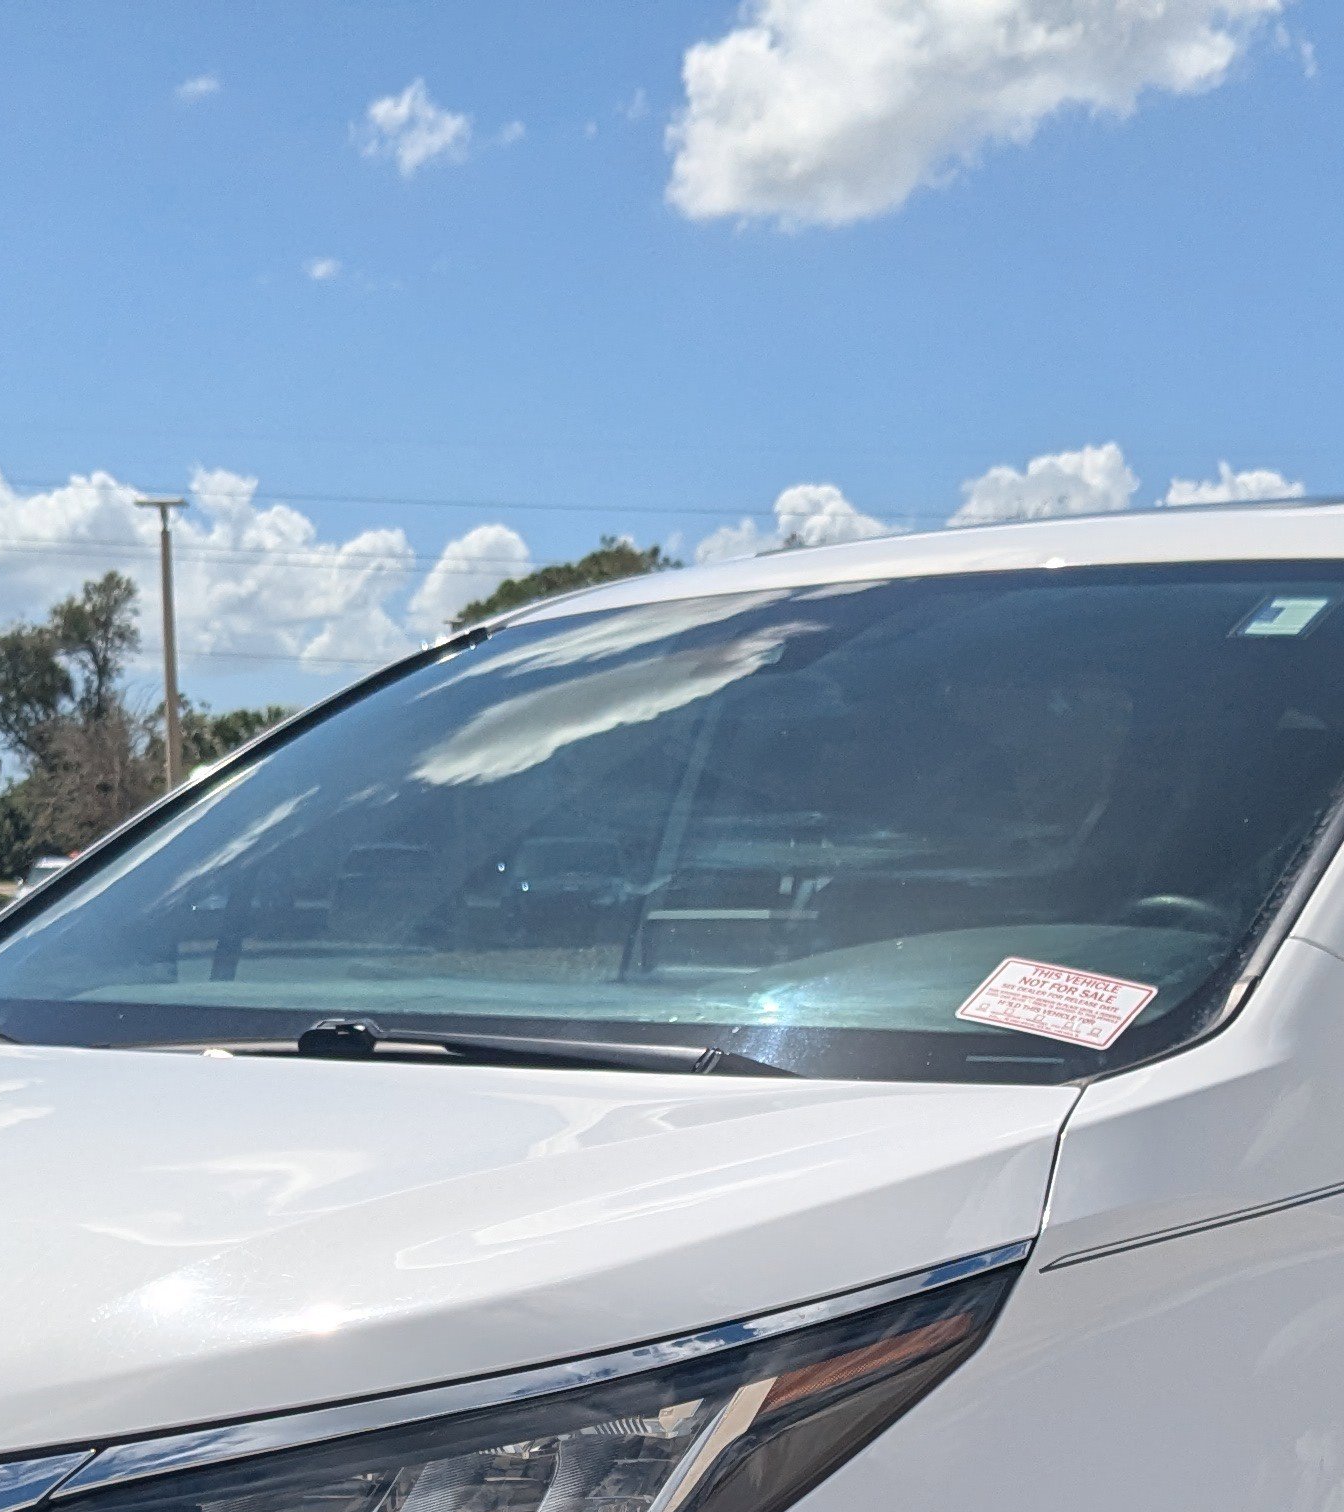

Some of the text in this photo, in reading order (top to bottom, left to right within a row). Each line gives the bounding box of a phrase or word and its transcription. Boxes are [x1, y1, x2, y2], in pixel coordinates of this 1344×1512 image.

[1019, 976, 1118, 1004] NOT FOR SALE
[1031, 967, 1122, 994] THIS VEHICLE
[1017, 986, 1047, 996] DEALER
[1047, 992, 1064, 1000] FOR
[1064, 996, 1098, 1008] RELEASE
[1022, 1005, 1042, 1013] THIS
